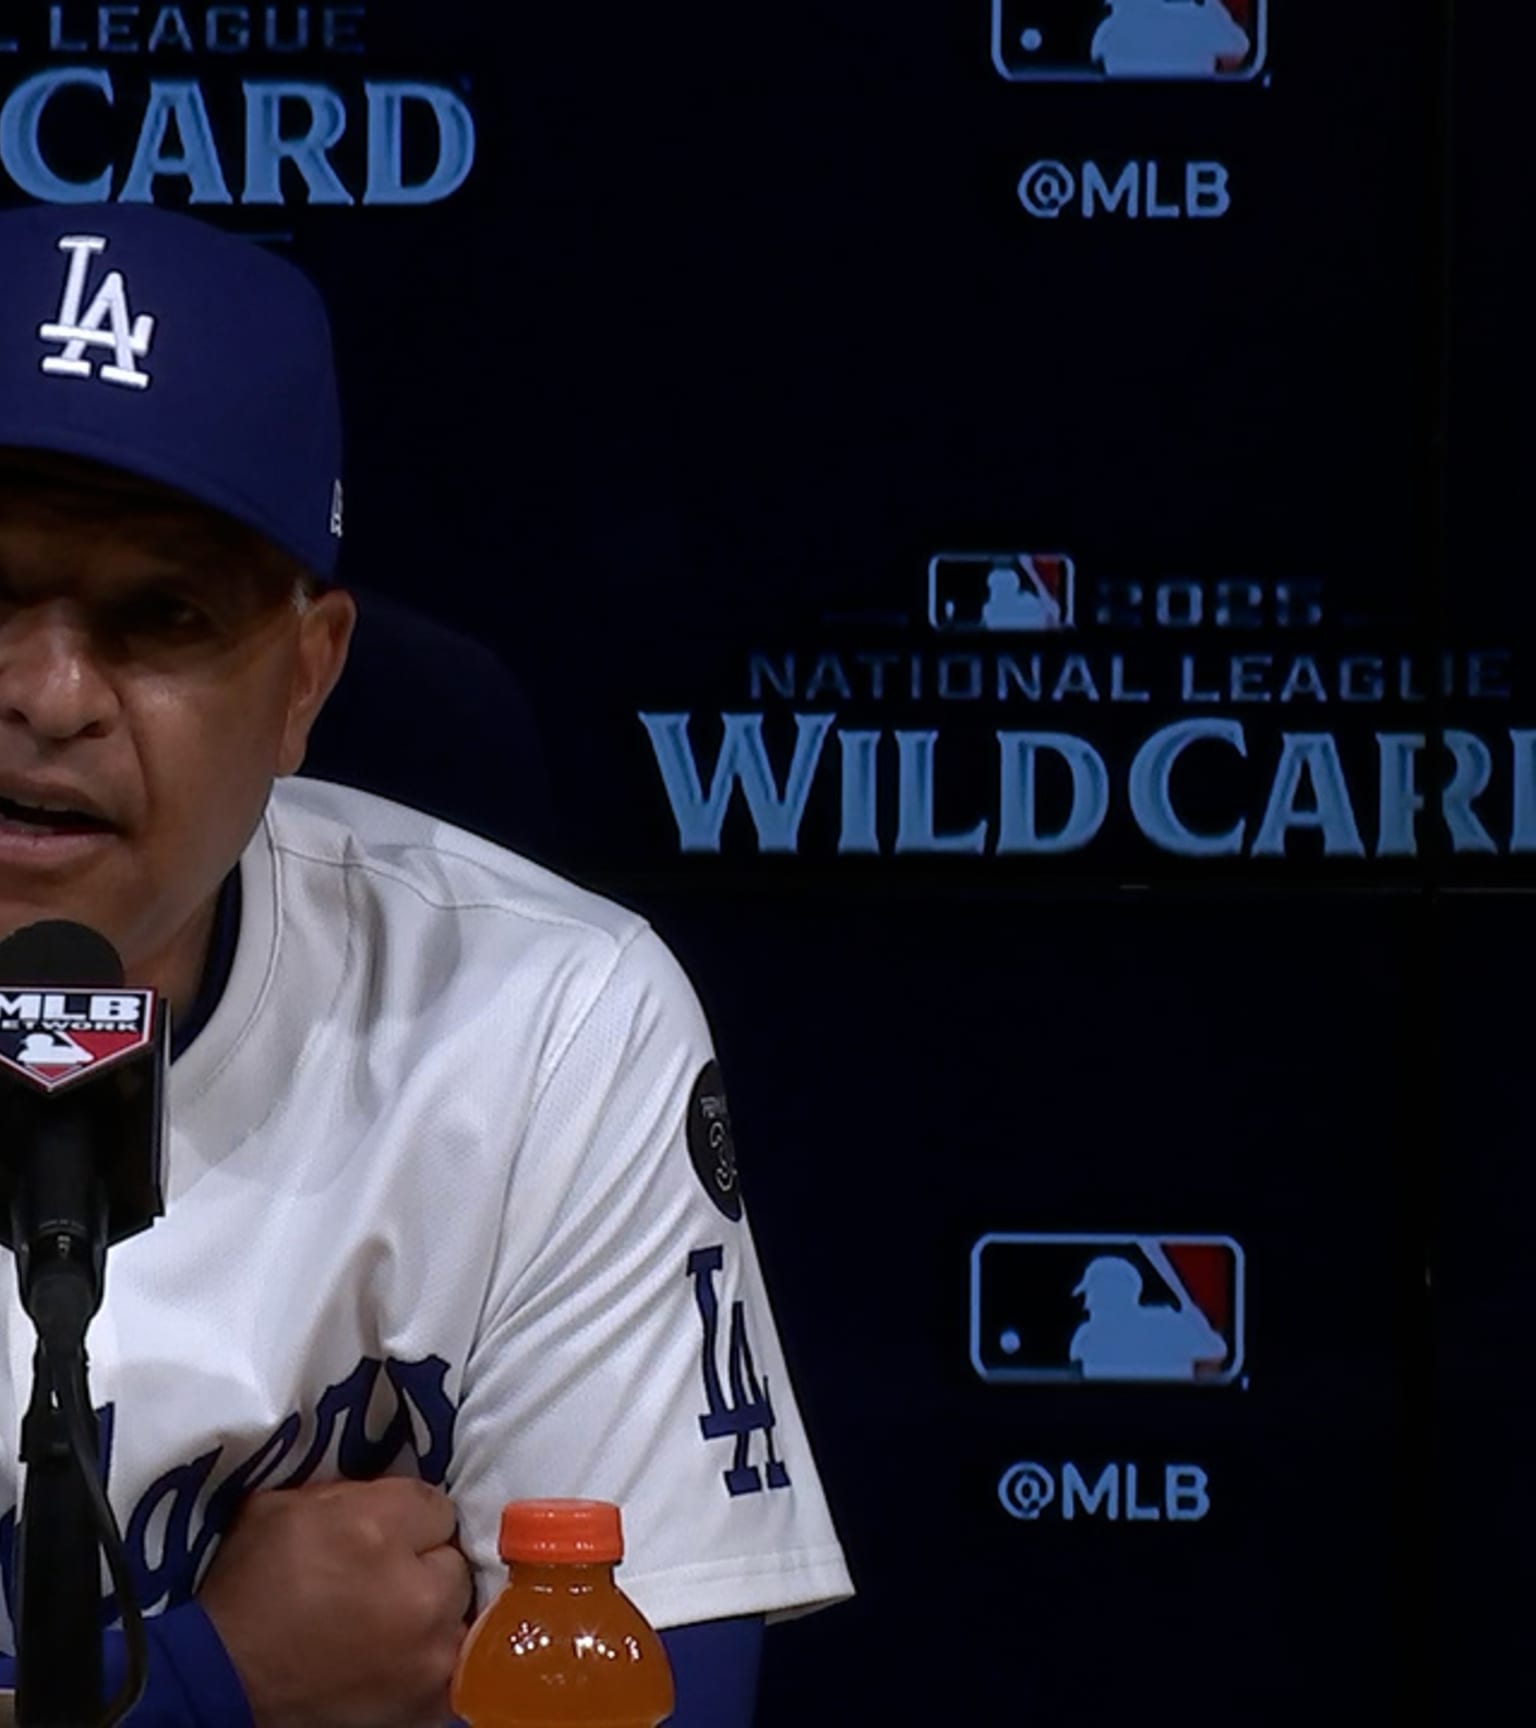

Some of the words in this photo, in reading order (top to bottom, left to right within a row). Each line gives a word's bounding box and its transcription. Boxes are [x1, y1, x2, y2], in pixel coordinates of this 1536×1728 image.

[49, 3, 365, 53] LEAGUE
[1017, 159, 1231, 219] @MLB
[38, 235, 154, 389] LA
[1095, 578, 1323, 627] 2025
[750, 652, 1151, 703] NATIONAL
[1180, 652, 1511, 703] LEAGUE
[638, 711, 1536, 856] WILDCAR
[997, 1461, 1211, 1521] @MLB
